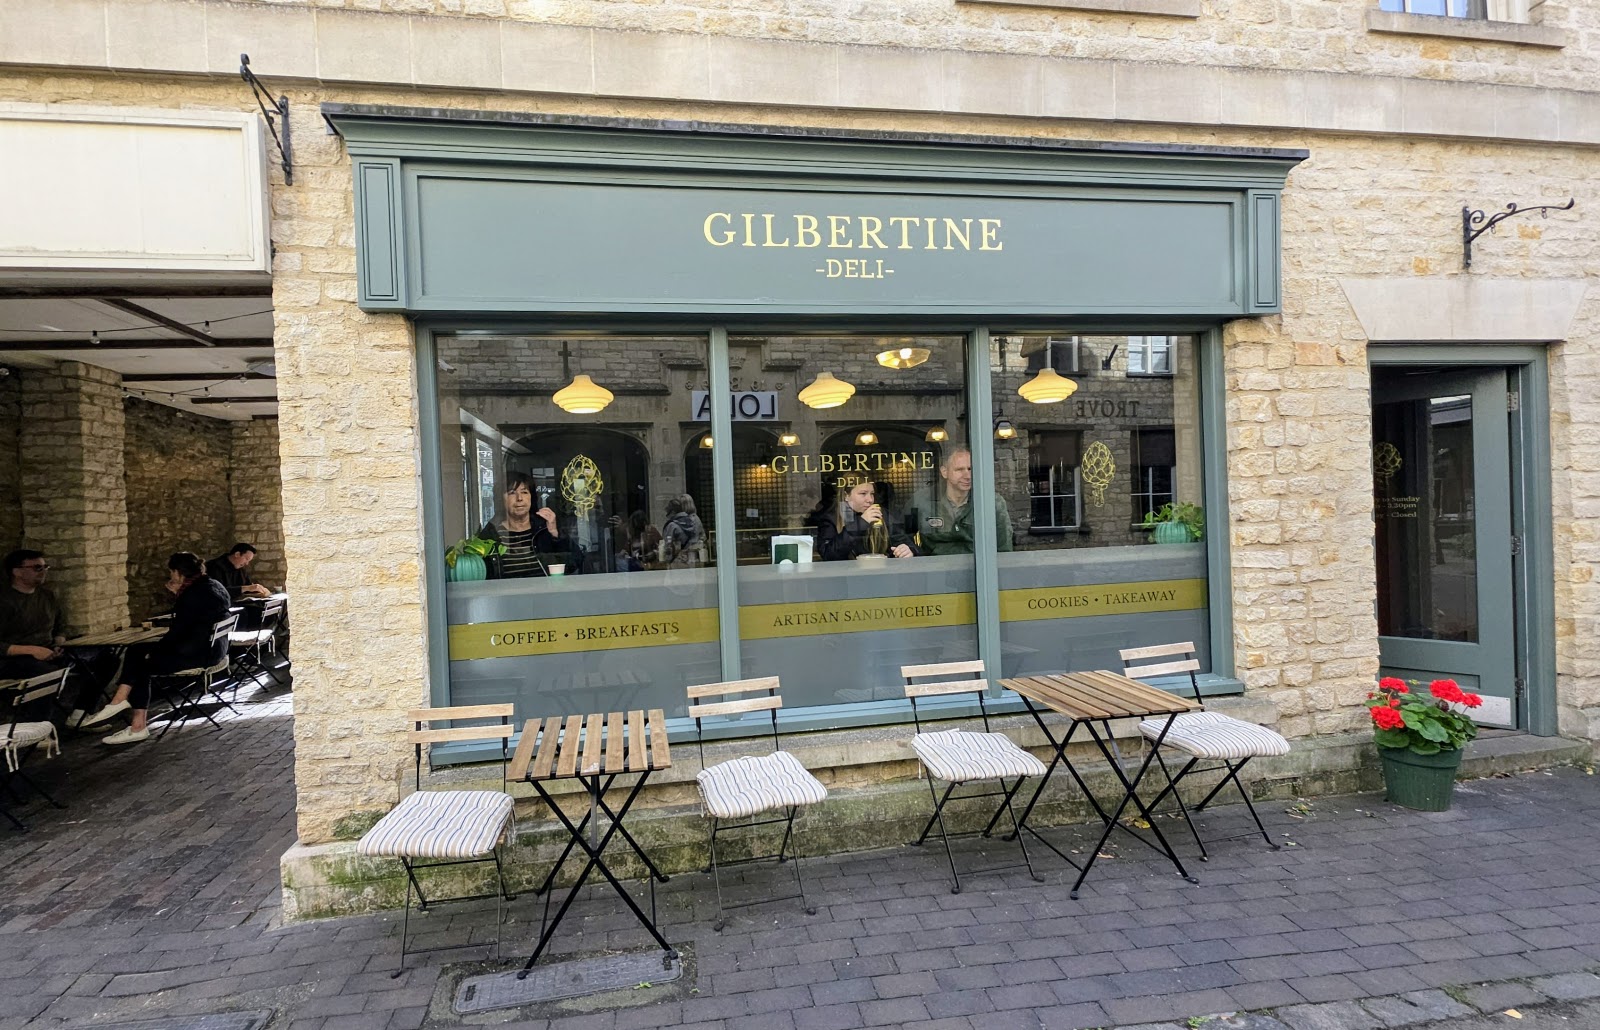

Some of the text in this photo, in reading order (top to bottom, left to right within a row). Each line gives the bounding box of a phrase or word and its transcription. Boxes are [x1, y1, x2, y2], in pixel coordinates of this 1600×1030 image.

[703, 212, 1003, 251] GILBERTINE
[815, 258, 895, 279] -DELI-
[771, 451, 934, 474] GILBERTINE
[1027, 589, 1177, 610] COOKIES TAKEAWAY
[772, 604, 943, 627] ARTISAN SANDWICHES
[490, 621, 680, 647] COFFEE BREAKFASTS
